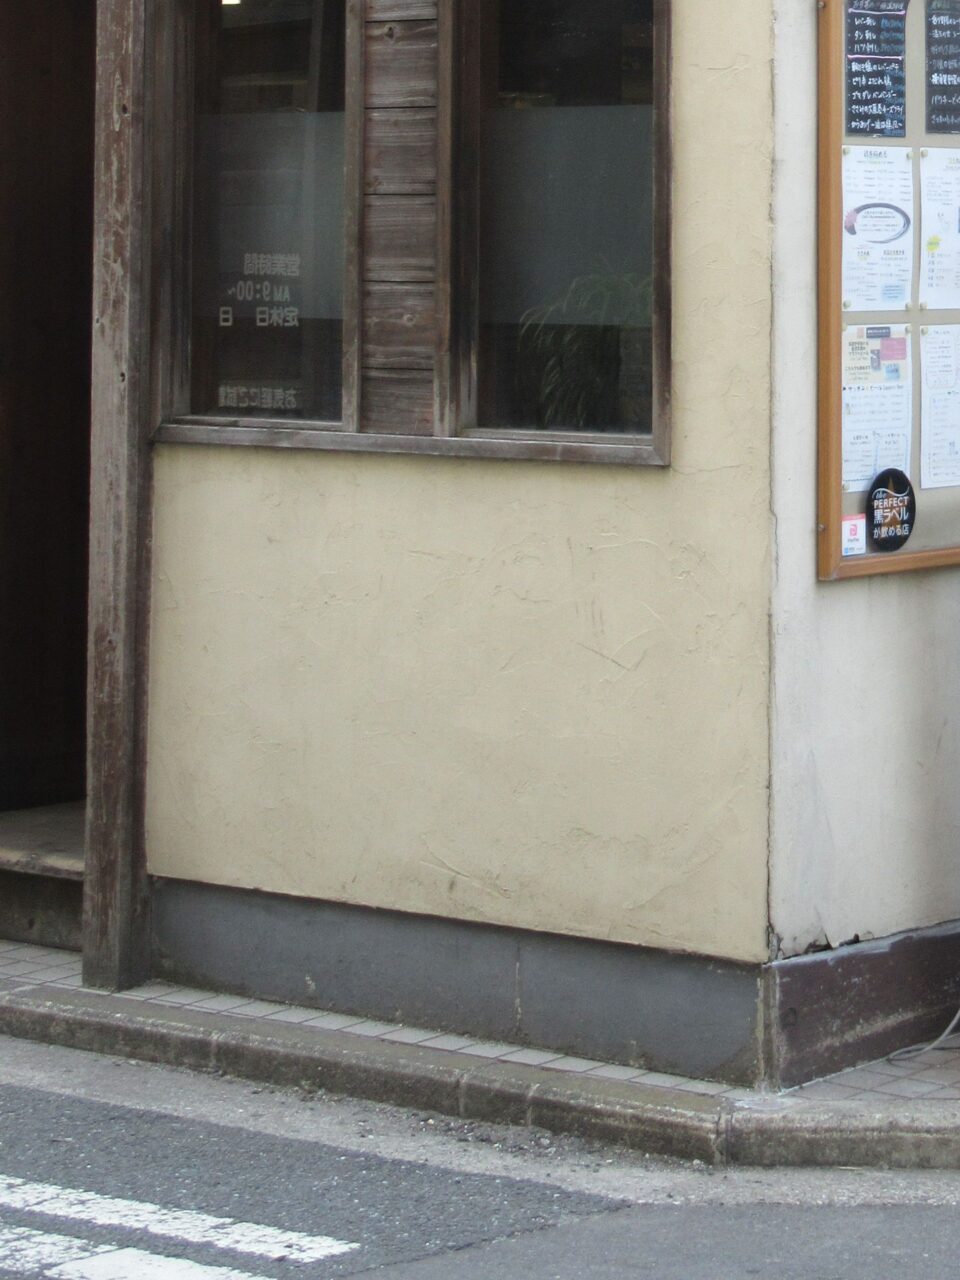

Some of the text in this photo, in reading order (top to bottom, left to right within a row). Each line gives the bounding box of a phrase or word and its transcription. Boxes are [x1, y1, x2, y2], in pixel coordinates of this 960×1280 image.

[874, 496, 909, 508] PERFECT
[873, 507, 909, 524] 黒ラベル
[873, 524, 910, 539] が飲める店
